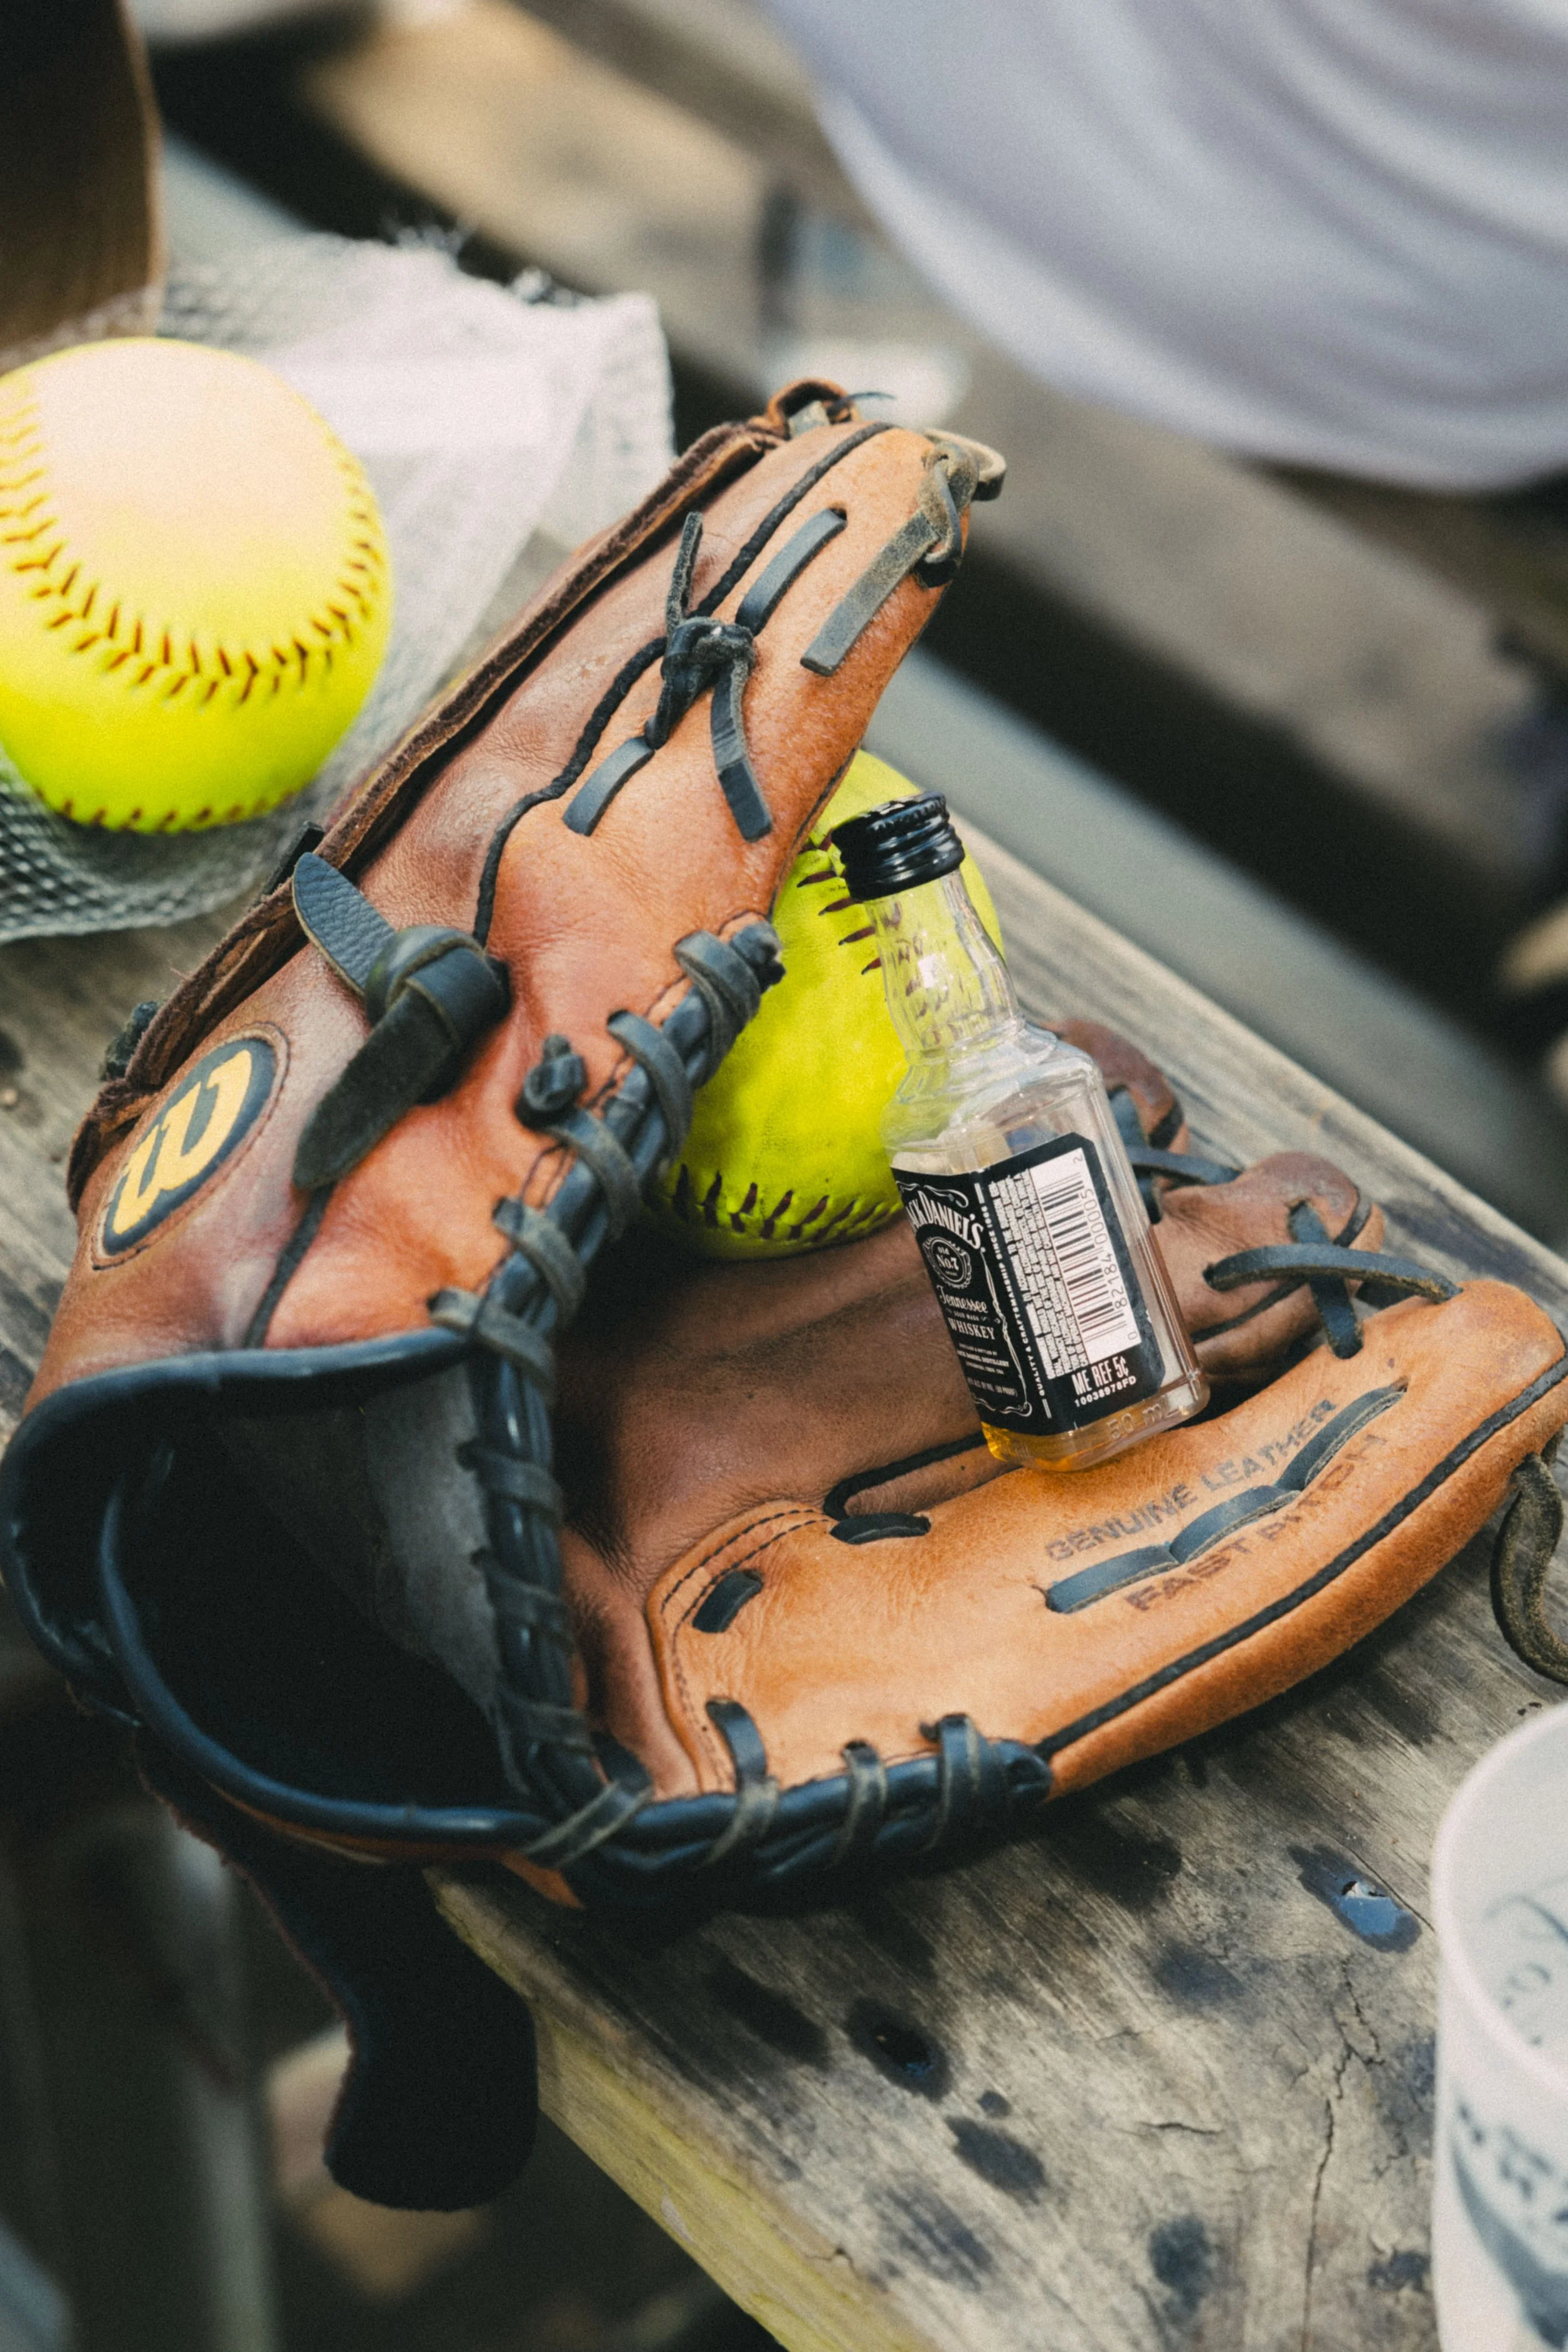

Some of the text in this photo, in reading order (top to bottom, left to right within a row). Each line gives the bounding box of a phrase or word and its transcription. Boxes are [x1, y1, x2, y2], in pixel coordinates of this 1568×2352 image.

[1073, 1156, 1083, 1164] 2
[918, 1190, 983, 1249] DANIEL'S
[1081, 1189, 1108, 1245] 00005
[988, 1229, 1003, 1260] SINCE
[936, 1285, 988, 1313] Tennessee
[1101, 1253, 1127, 1310] 82184
[999, 1261, 1029, 1344] CRAFTSMANSHIP
[948, 1317, 995, 1340] WHISKEY
[1027, 1354, 1045, 1396] QUALITY
[1071, 1355, 1129, 1396] ME REF 5¢
[1074, 1375, 1136, 1407] 10038978FD
[1106, 1412, 1134, 1439] 50
[1046, 1399, 1337, 1561] GENUINE LEATHER
[1125, 1537, 1253, 1611] FAST
